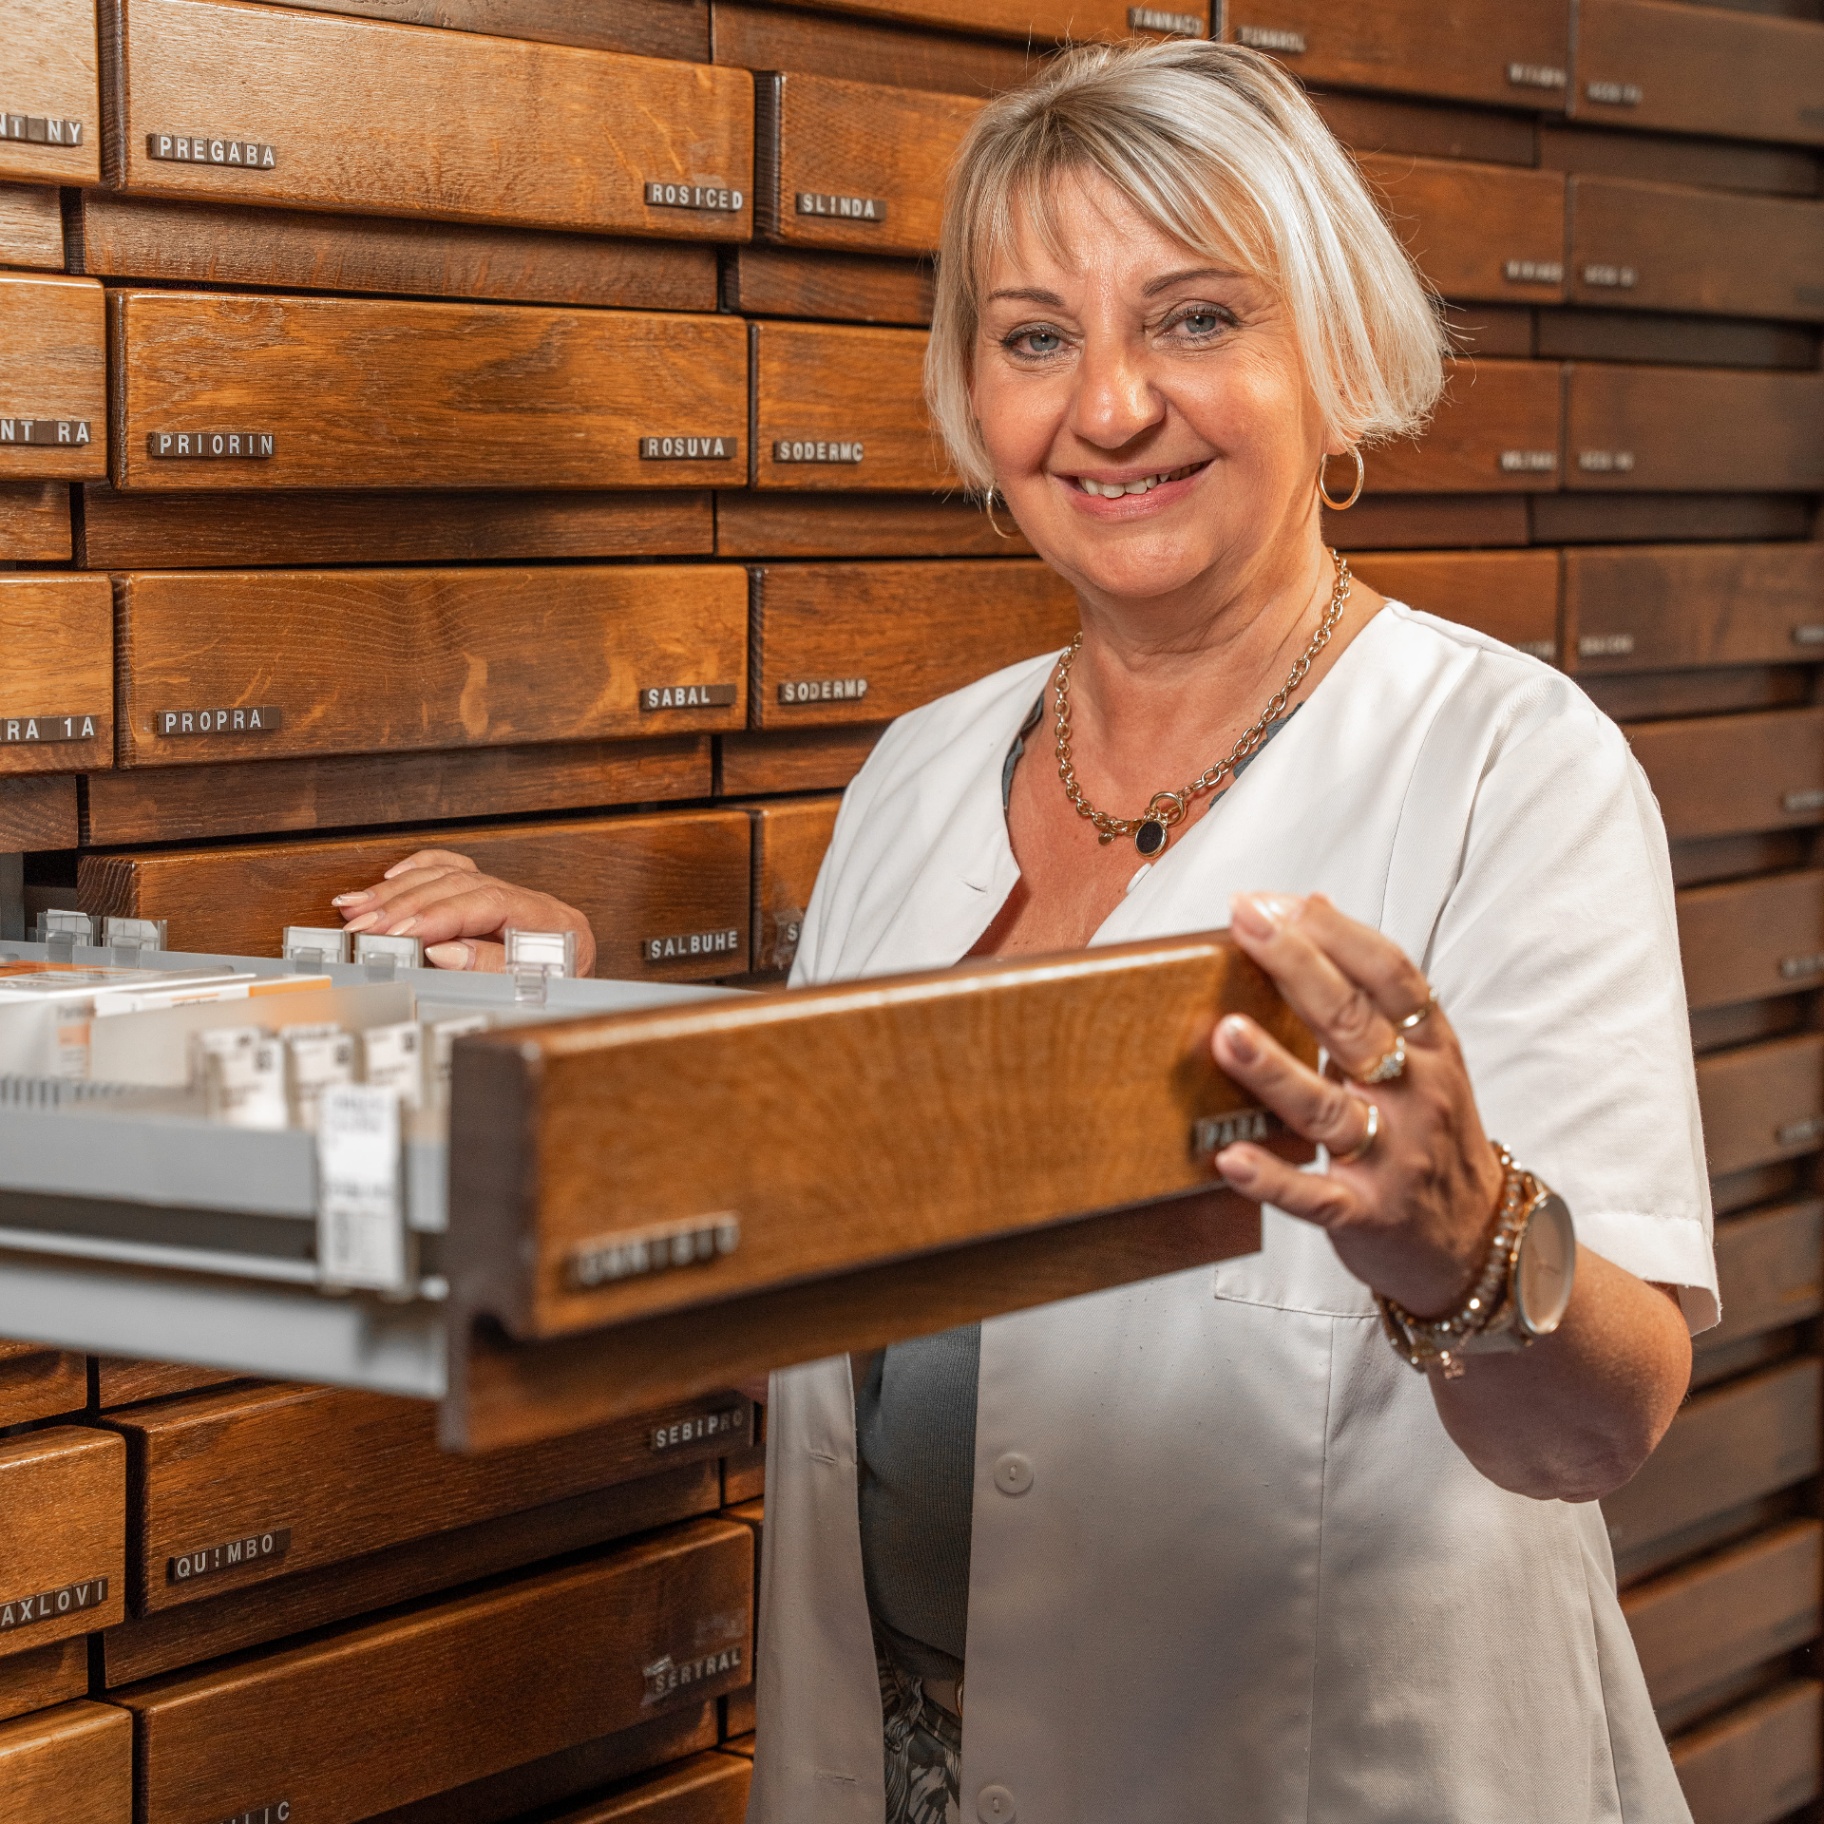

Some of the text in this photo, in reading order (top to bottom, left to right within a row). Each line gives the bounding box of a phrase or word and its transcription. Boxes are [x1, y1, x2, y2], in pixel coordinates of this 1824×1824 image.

[47, 120, 81, 143] NY
[159, 135, 275, 166] PREGABA
[652, 184, 743, 211] ROSICED
[803, 193, 876, 218] SLINDA
[0, 419, 89, 443] NT RA
[160, 433, 274, 456] PRIORIN
[648, 437, 725, 457] ROSUVA
[779, 441, 864, 462] SODERMC
[648, 686, 711, 707] SABAL
[784, 678, 868, 701] SODERMP
[0, 717, 95, 741] RA 1A
[165, 708, 262, 733] PROPRA
[650, 930, 739, 960] SALBUHE
[655, 1408, 745, 1448] SEBIPRO
[0, 1581, 103, 1627] AXLOVI
[654, 1648, 742, 1693] SERTRAL
